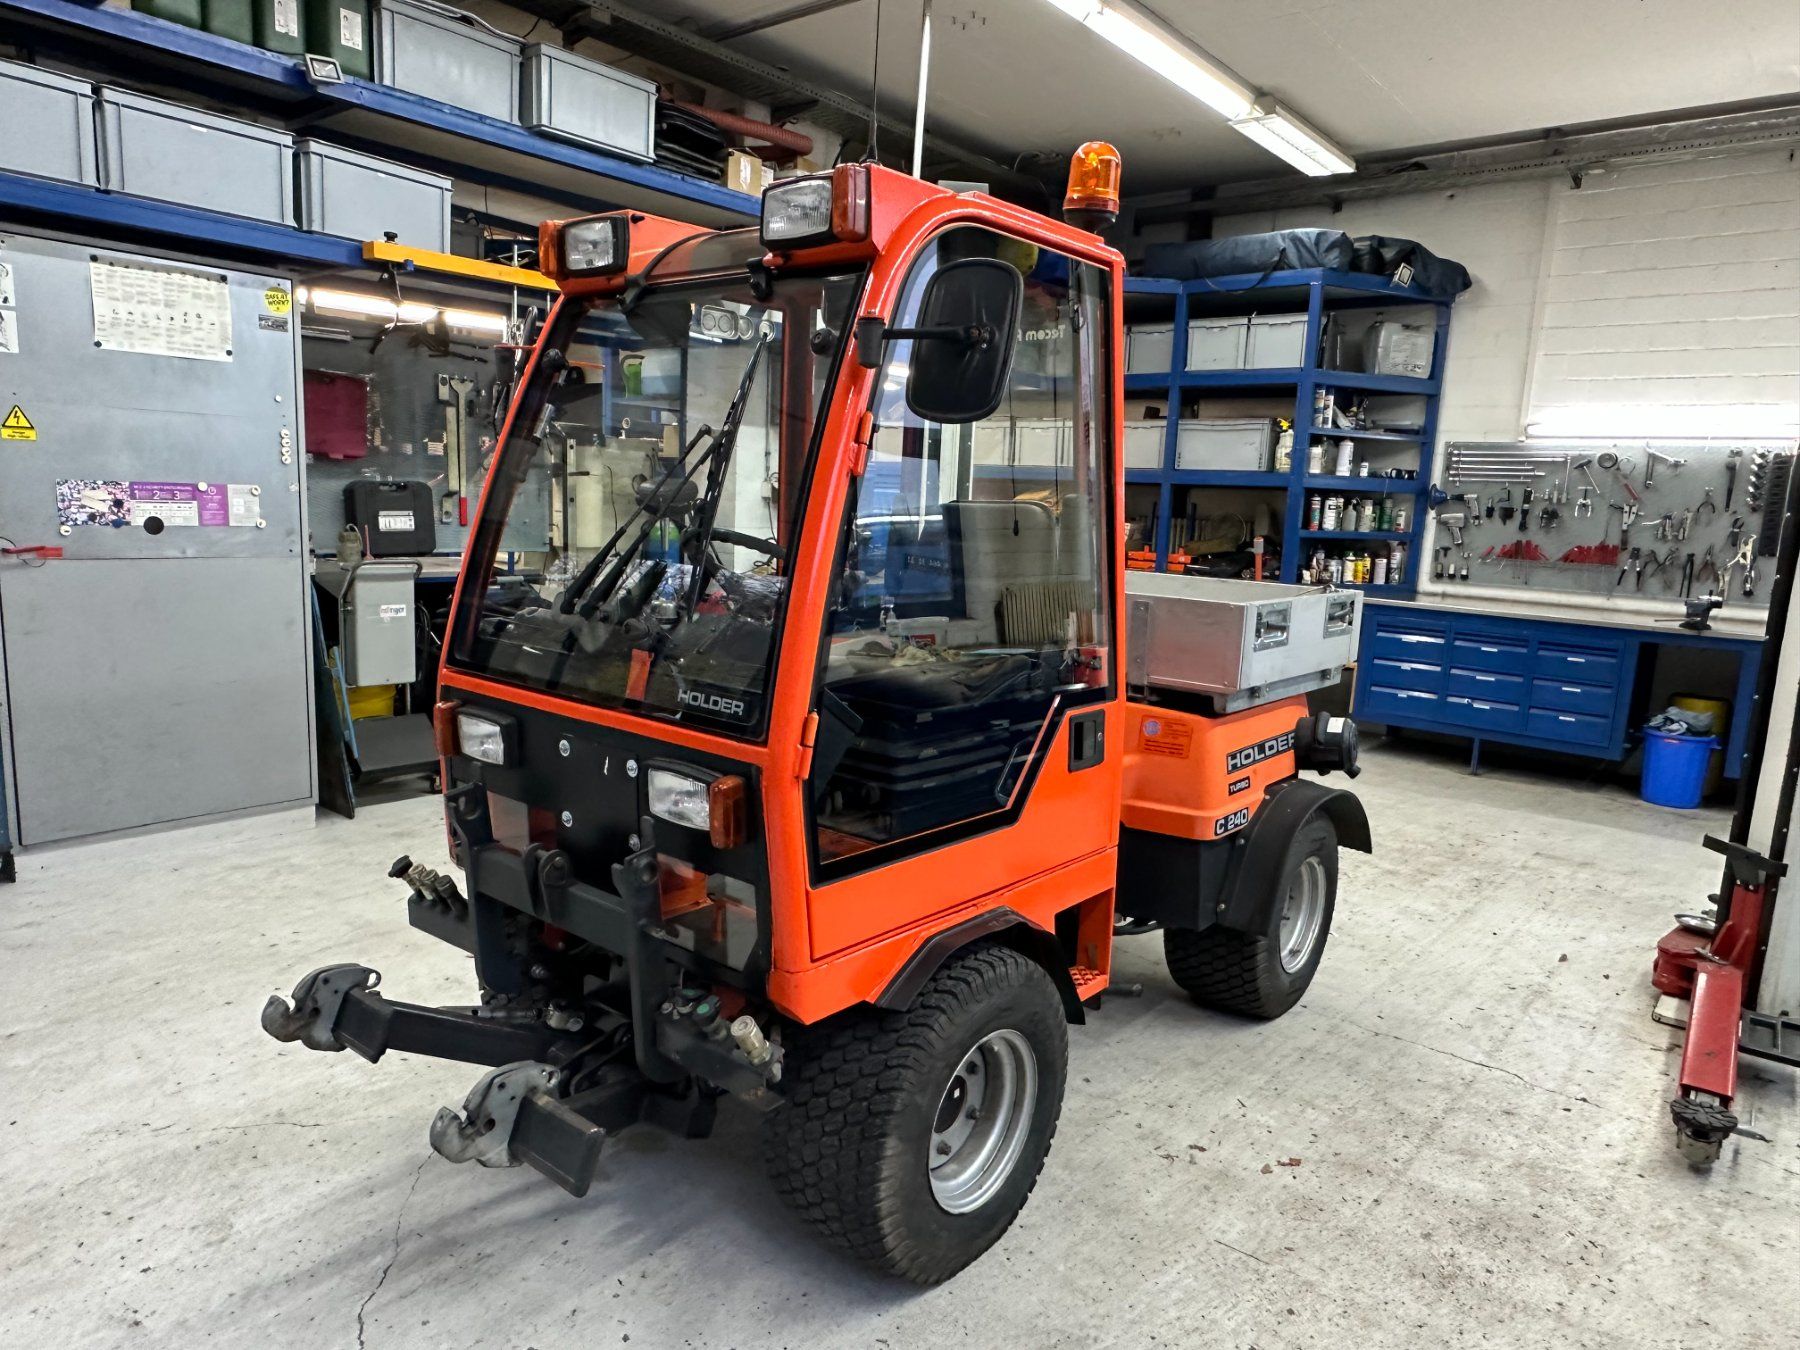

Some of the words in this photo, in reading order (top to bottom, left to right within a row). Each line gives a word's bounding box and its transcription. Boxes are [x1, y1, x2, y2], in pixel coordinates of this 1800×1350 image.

[153, 490, 160, 500] 2
[173, 490, 180, 500] 3
[677, 688, 744, 716] HOLDER
[1229, 779, 1249, 793] TURBO
[1216, 818, 1225, 834] C
[1227, 808, 1248, 831] 240
